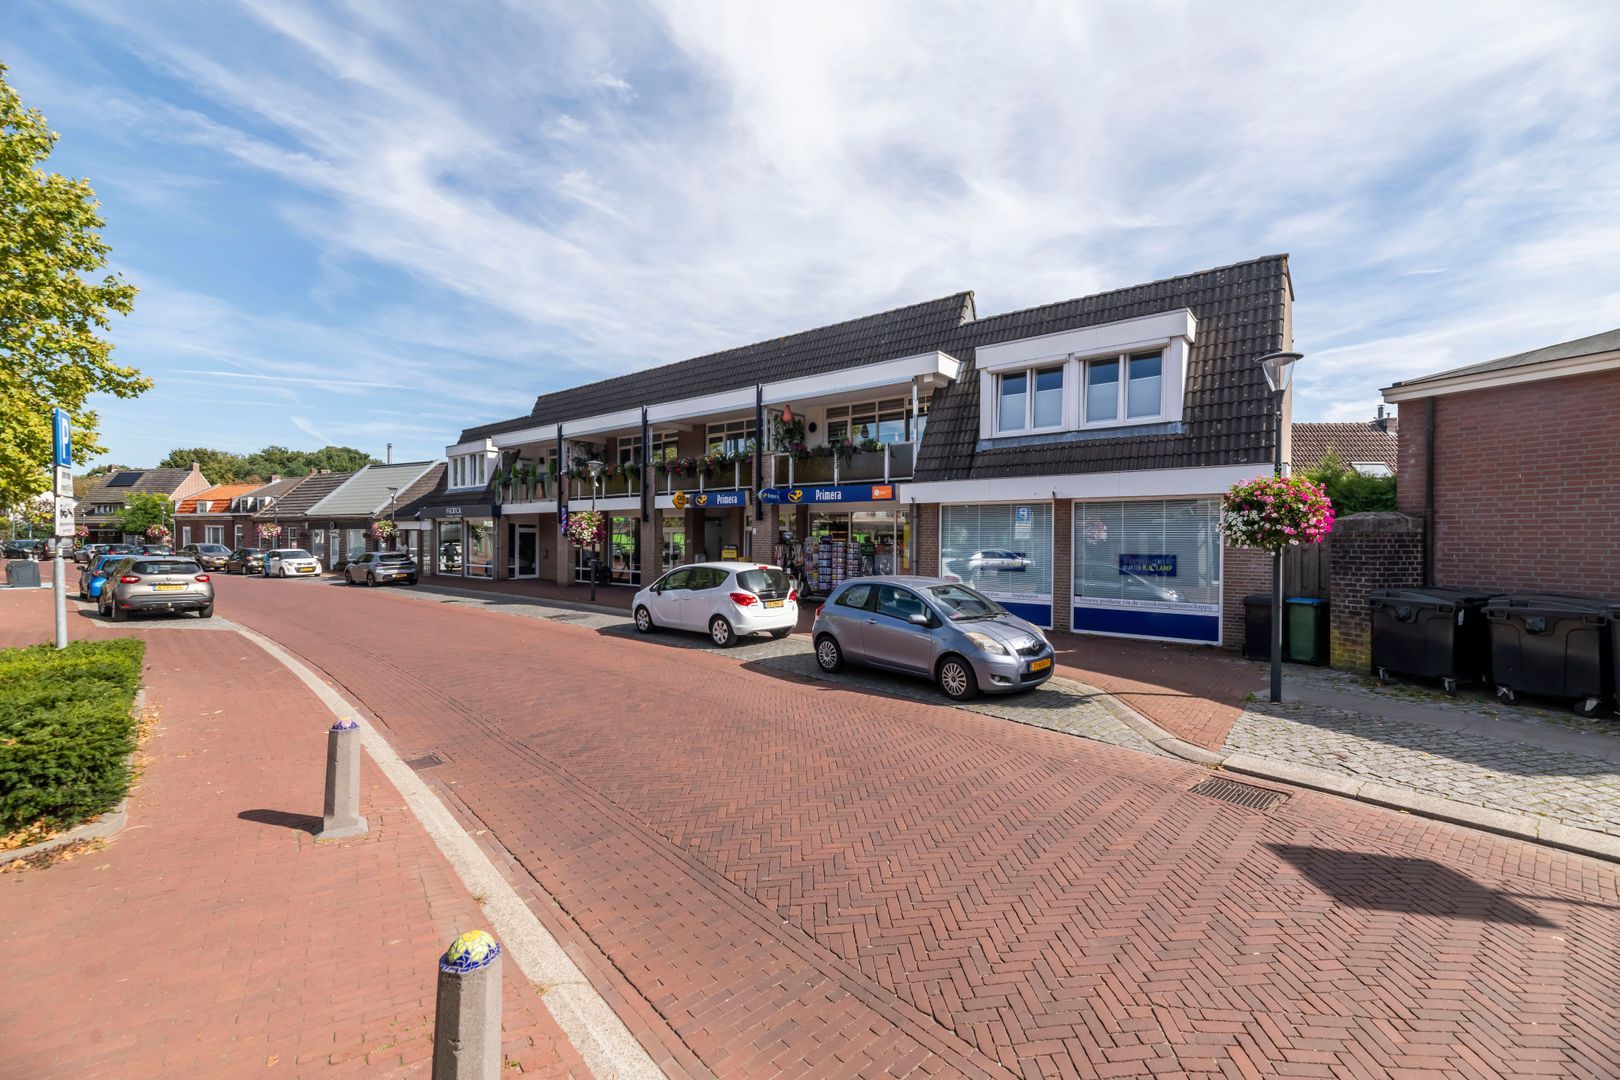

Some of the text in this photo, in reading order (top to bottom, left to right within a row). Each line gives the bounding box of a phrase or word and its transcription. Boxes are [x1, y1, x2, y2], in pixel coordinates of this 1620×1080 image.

[61, 417, 69, 459] P
[716, 494, 738, 504] Primera
[815, 490, 842, 500] Primera
